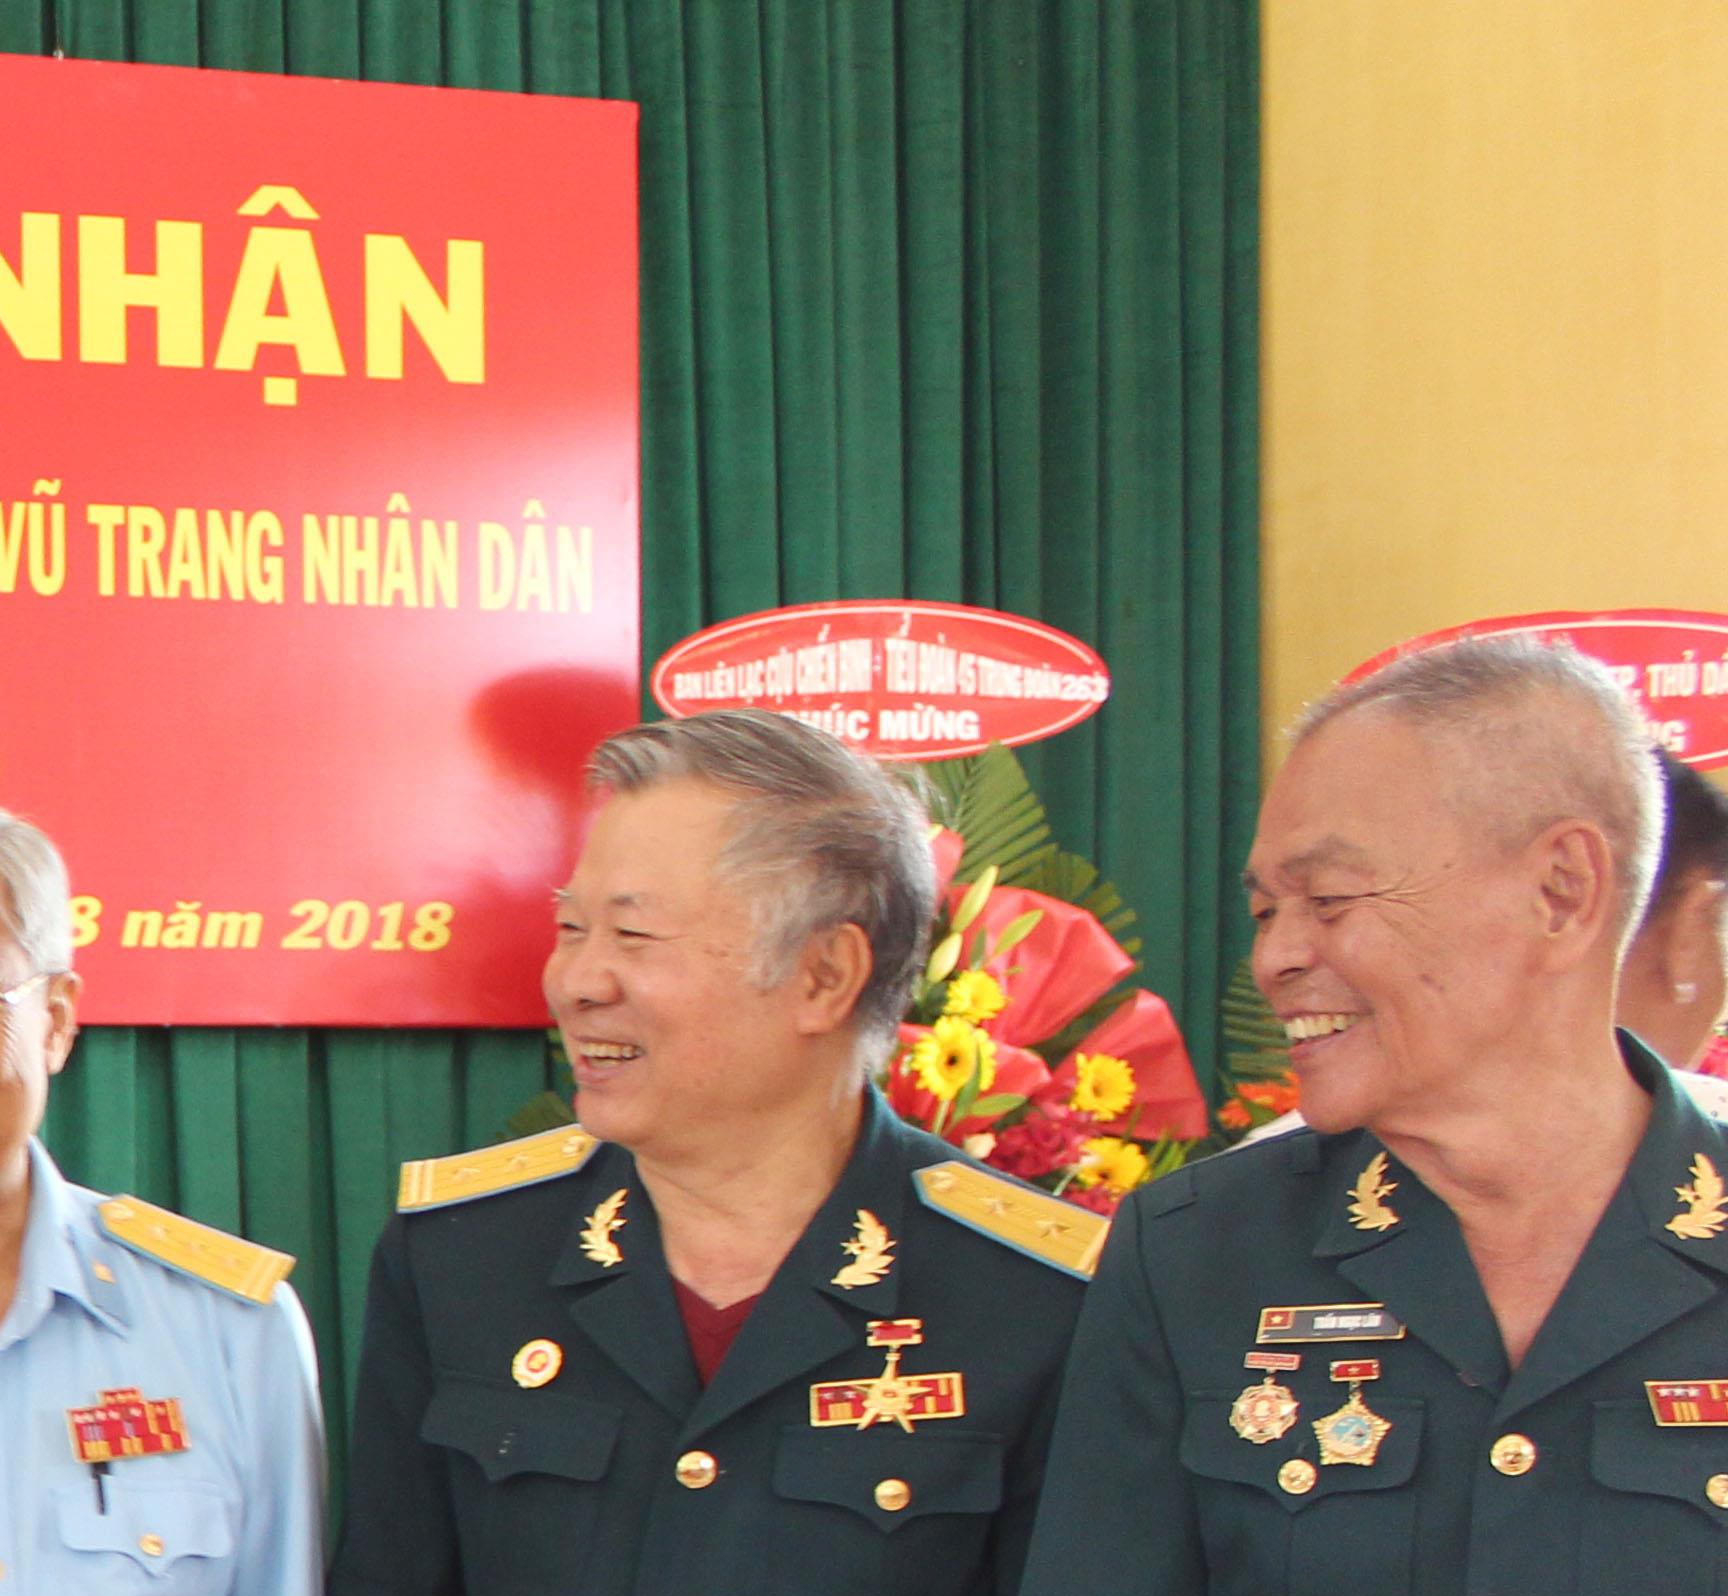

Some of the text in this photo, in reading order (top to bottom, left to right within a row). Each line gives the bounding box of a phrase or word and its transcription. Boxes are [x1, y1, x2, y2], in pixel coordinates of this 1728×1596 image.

[87, 503, 284, 605] TRANG
[302, 492, 459, 609] NHÂN
[478, 498, 594, 613] DÂN
[1646, 650, 1697, 697] THỦ
[780, 702, 980, 741] HÚC MỪNG
[121, 901, 264, 949] năm
[281, 899, 455, 951] 2018
